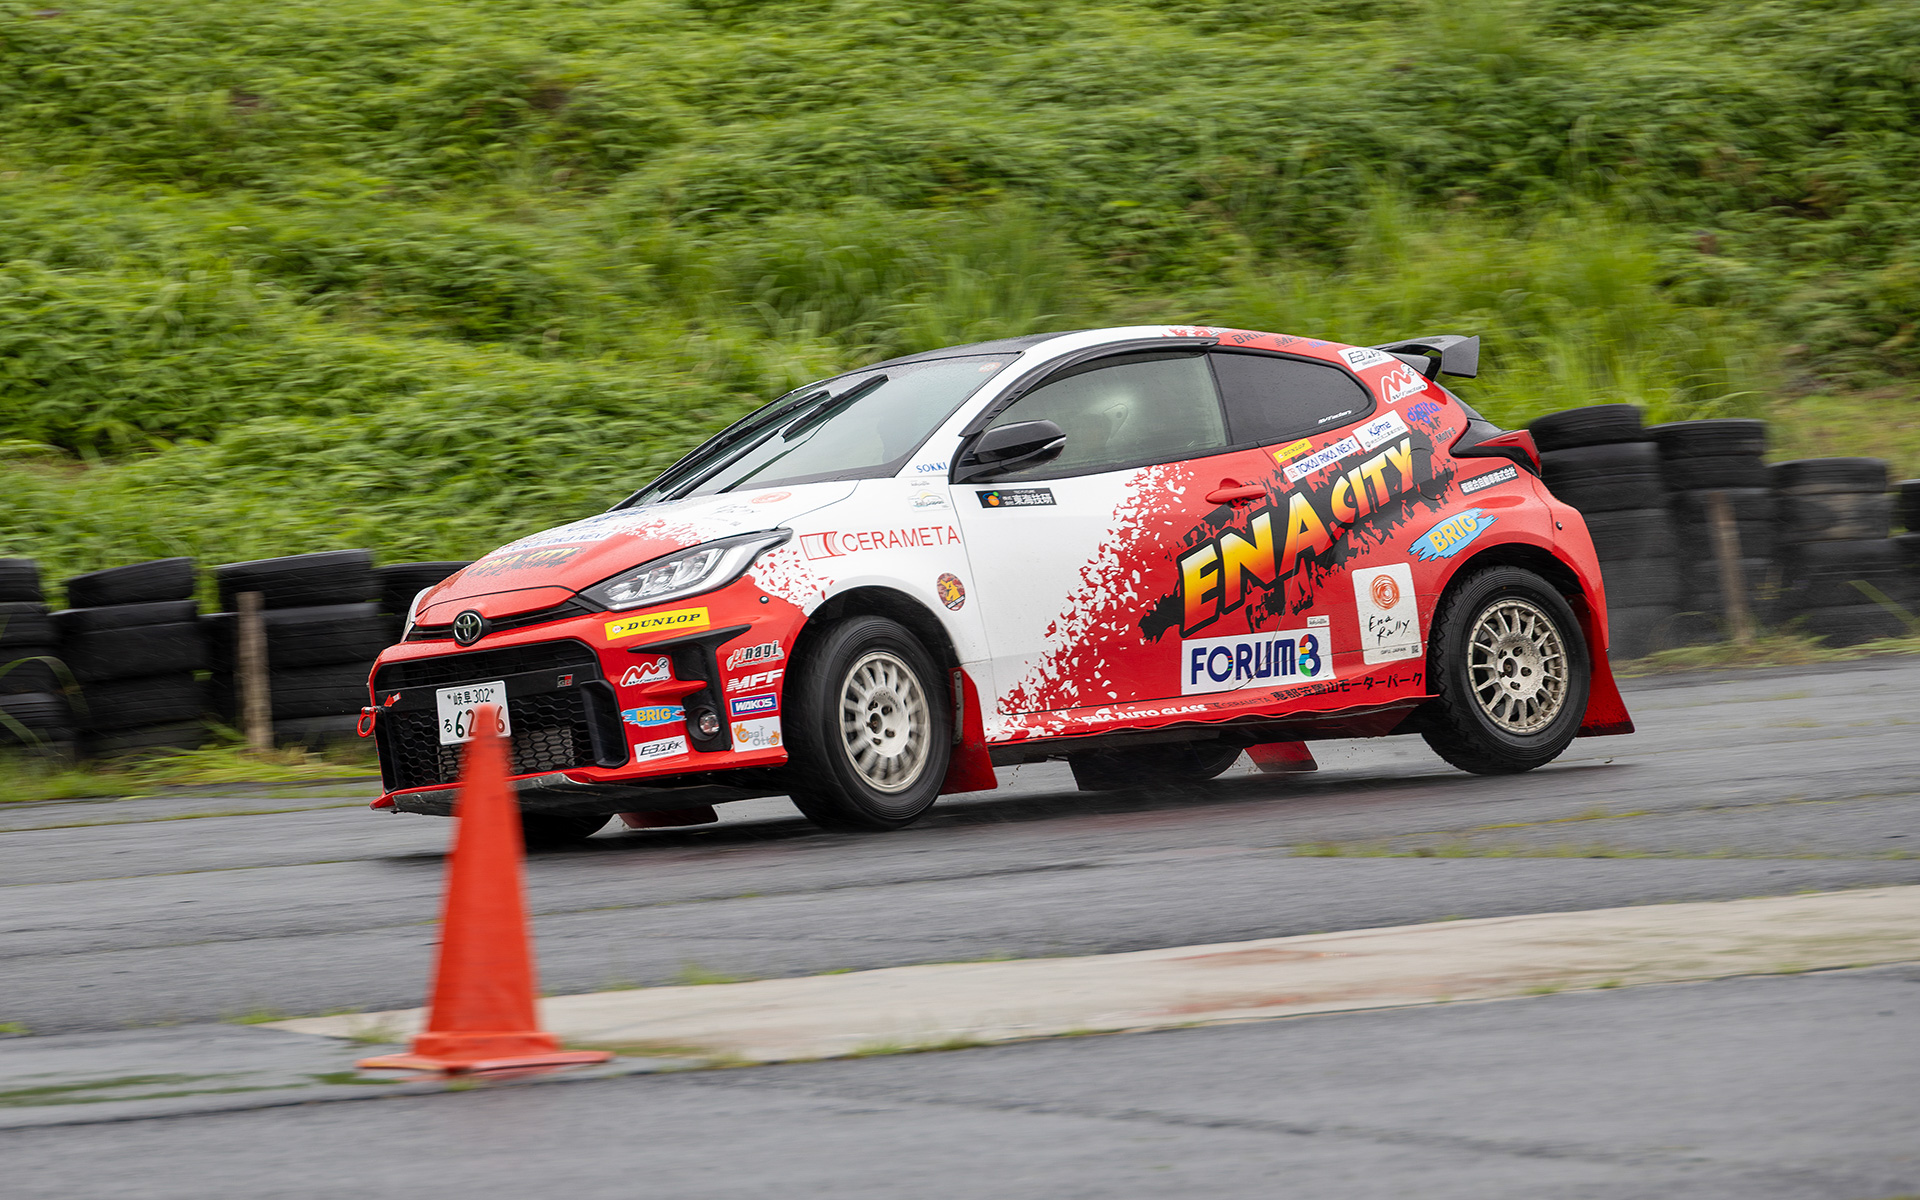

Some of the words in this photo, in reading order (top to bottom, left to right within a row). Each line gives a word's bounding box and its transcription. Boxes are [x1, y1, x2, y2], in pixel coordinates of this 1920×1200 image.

[916, 461, 948, 473] SOKKI
[1295, 457, 1319, 475] TOKAI
[1319, 449, 1337, 465] RIKA
[1338, 439, 1356, 457] NEXT
[842, 525, 962, 552] CERAMETA
[1180, 490, 1334, 634] ENA
[1330, 436, 1415, 525] CITY
[1428, 514, 1478, 553] BRIG
[627, 613, 701, 631] DUNLOP
[1368, 614, 1394, 633] Ena
[1376, 619, 1410, 646] Rally
[1190, 633, 1322, 685] FORUM8
[725, 668, 784, 692] MFF
[636, 708, 671, 722] BRIG
[735, 698, 773, 712] WAKOS
[1115, 709, 1161, 721] AUTO
[1161, 703, 1207, 716] GLASS
[443, 718, 453, 733] る
